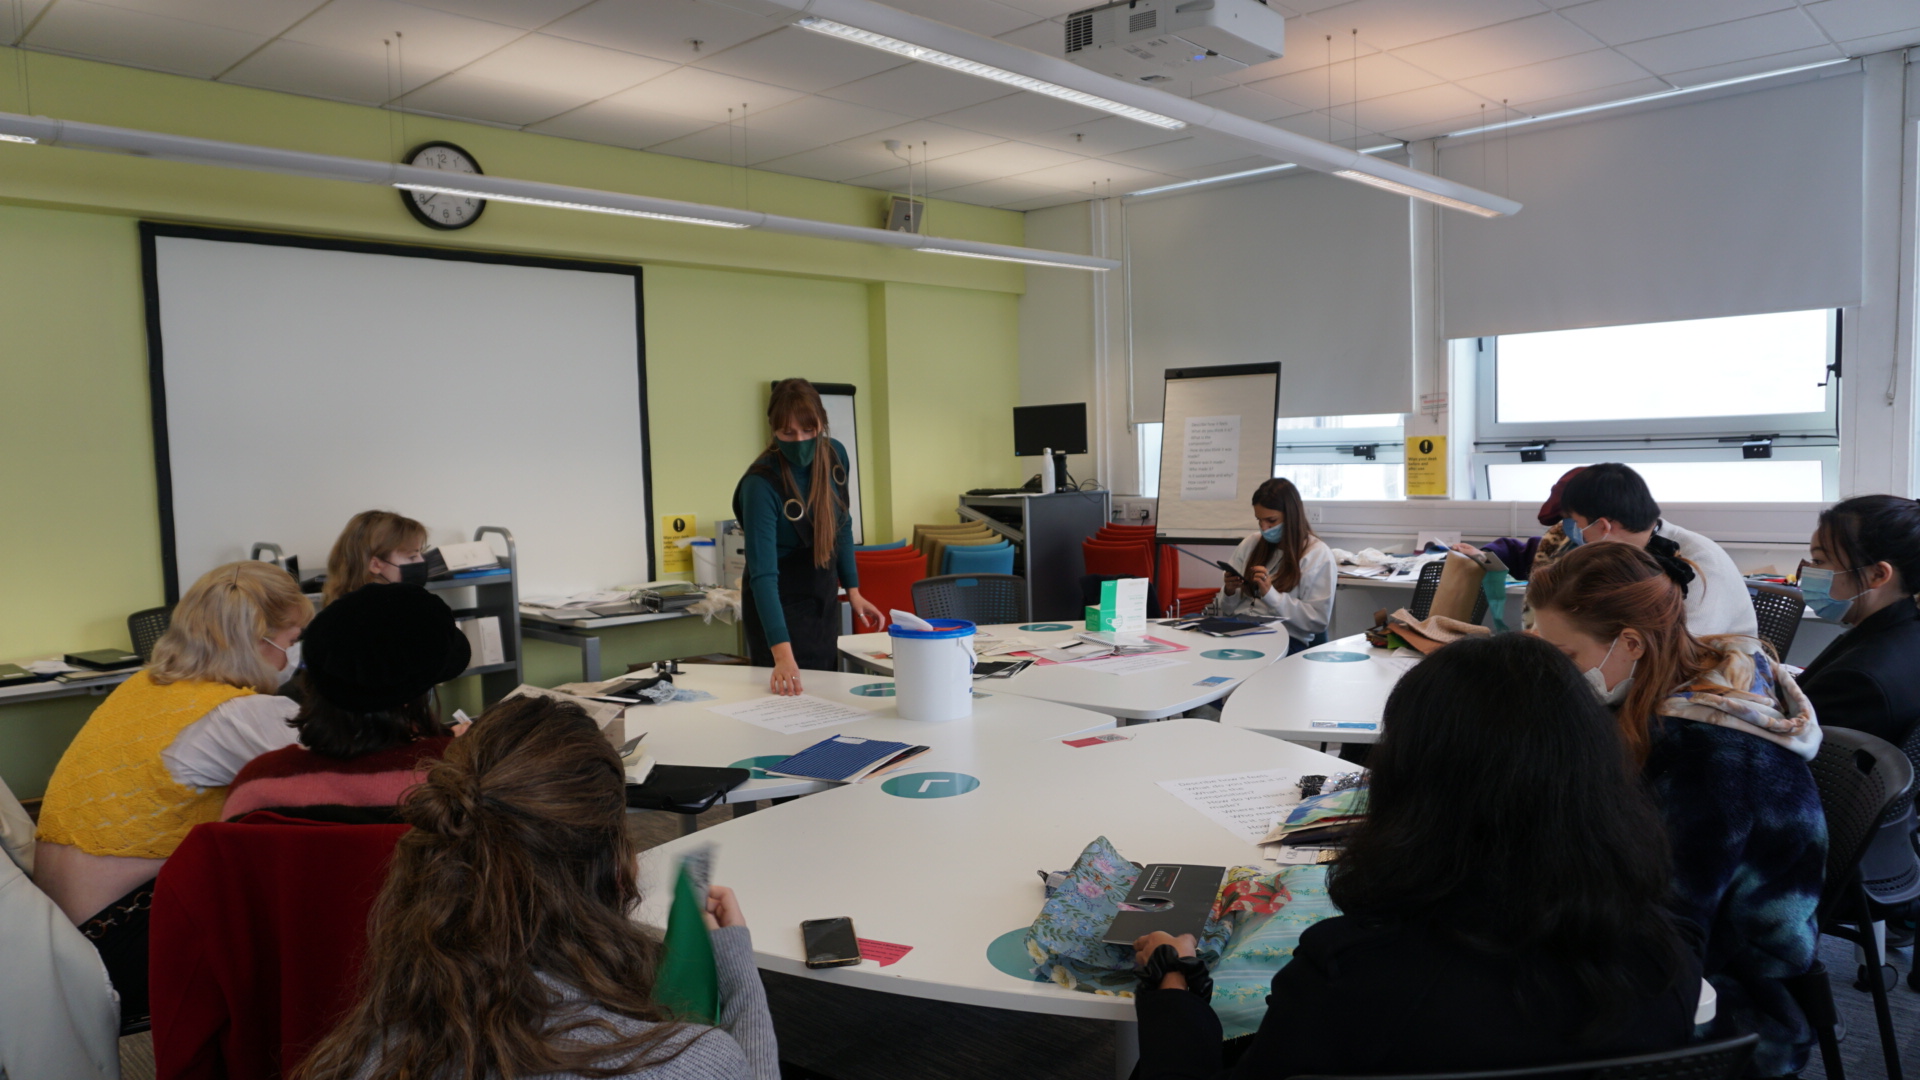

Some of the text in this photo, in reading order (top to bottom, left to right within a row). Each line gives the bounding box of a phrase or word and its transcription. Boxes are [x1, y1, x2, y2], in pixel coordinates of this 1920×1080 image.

[425, 156, 434, 166] 11
[437, 153, 447, 163] 12
[453, 158, 457, 168] 1
[419, 194, 426, 202] 8
[465, 198, 471, 206] 4
[429, 204, 435, 214] 7
[442, 208, 450, 219] 6
[456, 206, 462, 216] 5
